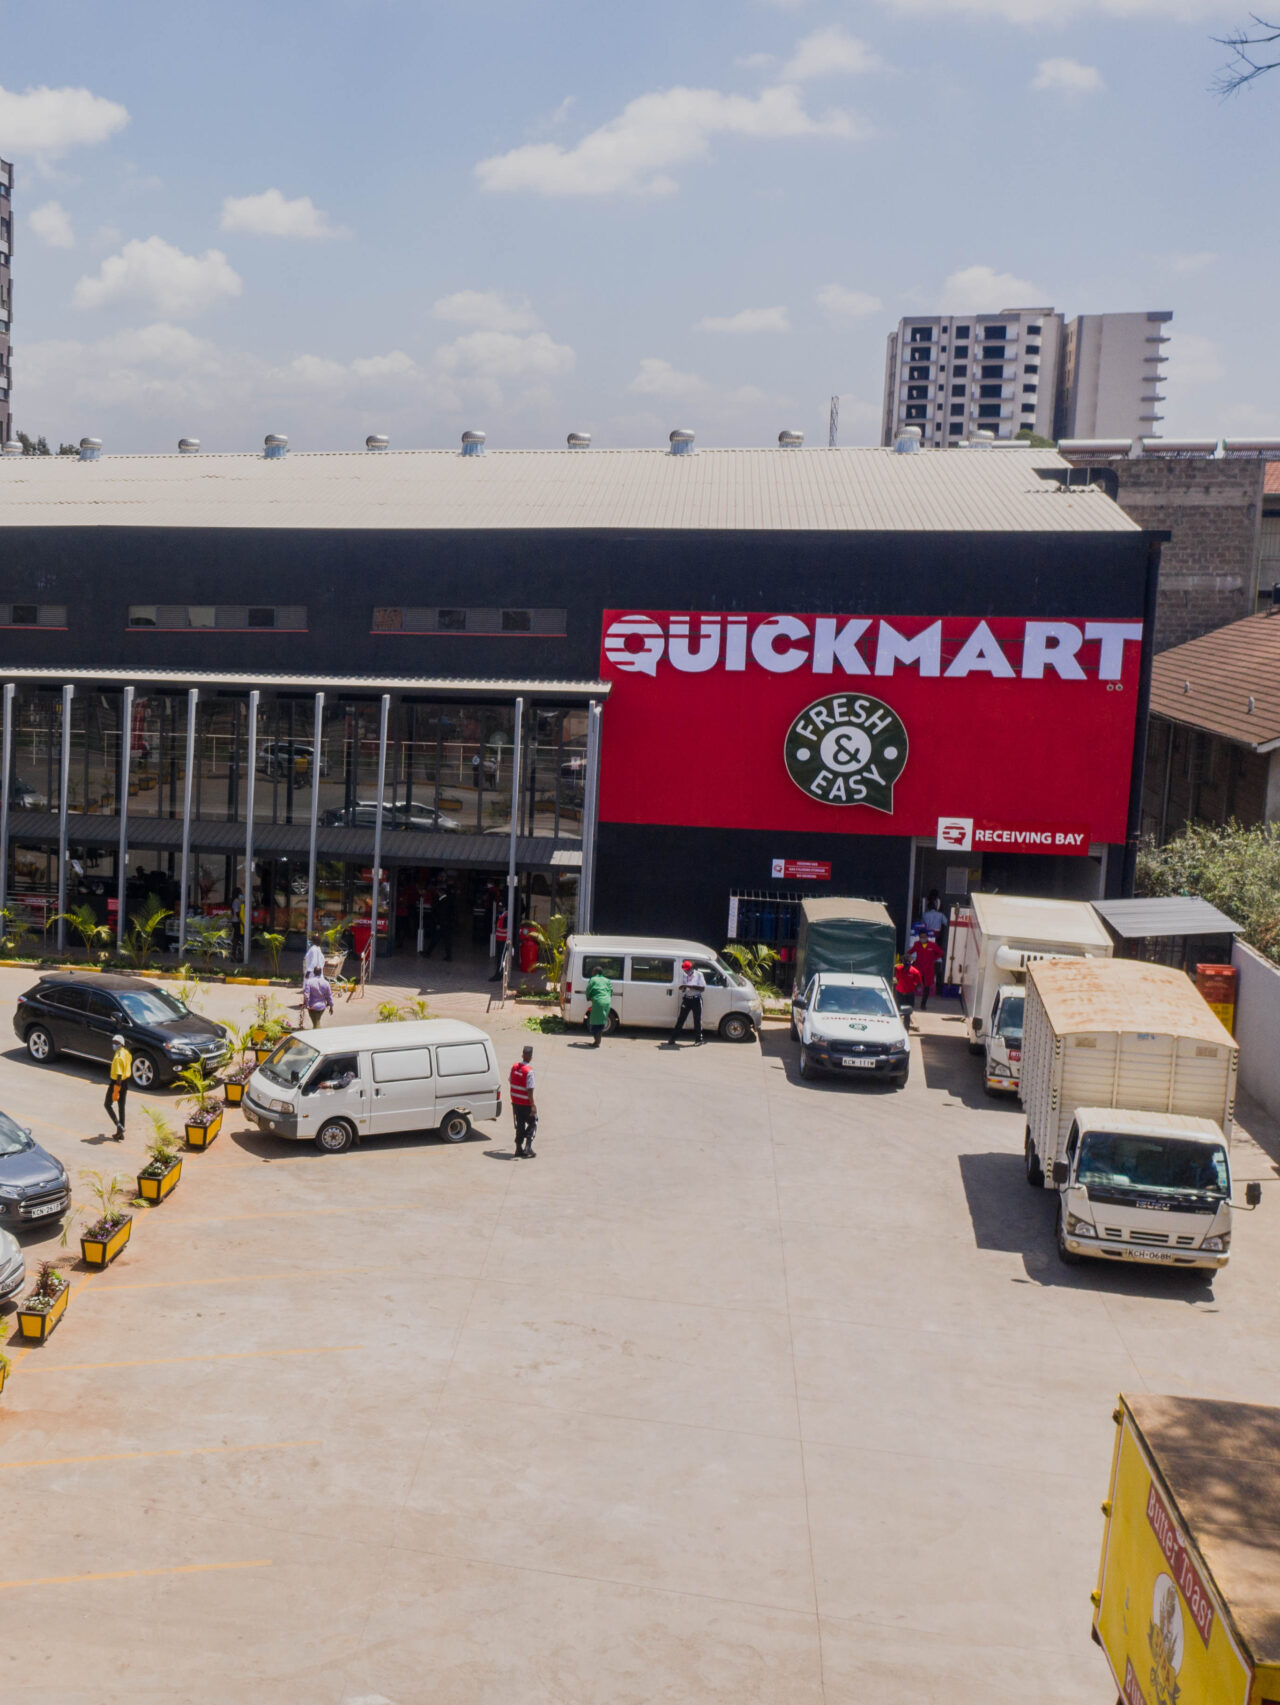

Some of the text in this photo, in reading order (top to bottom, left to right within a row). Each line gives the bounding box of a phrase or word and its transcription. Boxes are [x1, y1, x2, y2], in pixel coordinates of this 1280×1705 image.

[604, 615, 1143, 680] QUICKMART
[796, 697, 893, 741] FRESH
[832, 733, 861, 765] &
[810, 764, 887, 801] EASY
[975, 828, 1085, 846] RECEIVING BAY
[1147, 1488, 1213, 1640] Butter Toast
